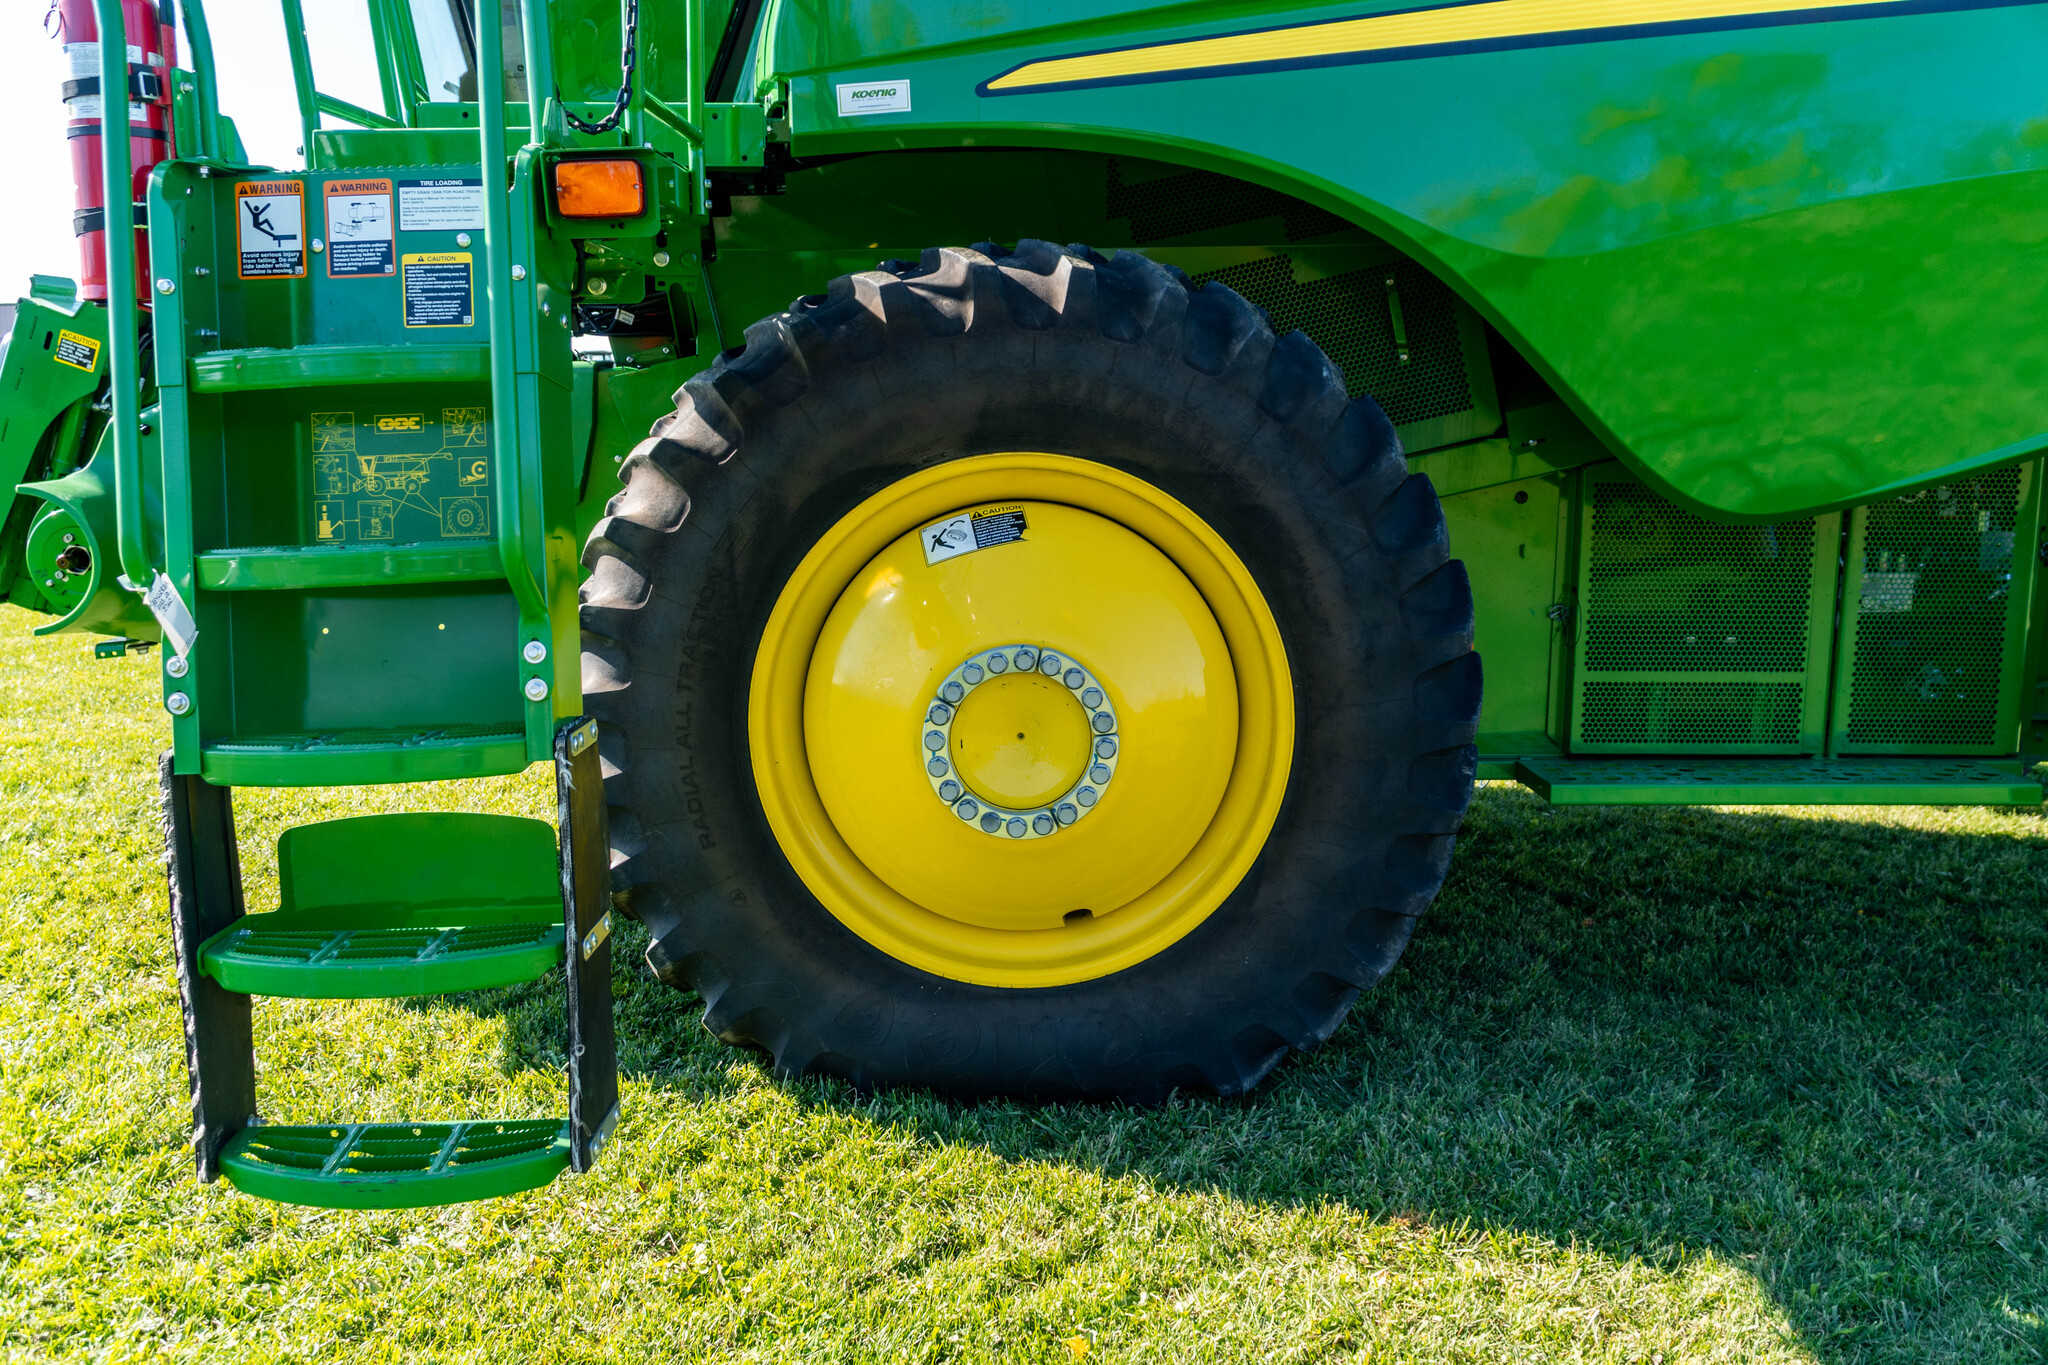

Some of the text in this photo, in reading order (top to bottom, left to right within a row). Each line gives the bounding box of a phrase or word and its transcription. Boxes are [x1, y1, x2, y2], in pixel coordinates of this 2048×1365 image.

[249, 183, 300, 194] WARNING
[340, 182, 387, 192] WARNING
[68, 333, 98, 347] CAUTION
[983, 505, 1021, 515] CAUTION
[676, 567, 722, 693] TRACTION
[676, 702, 691, 748] ALL
[680, 756, 716, 849] RADIAL
